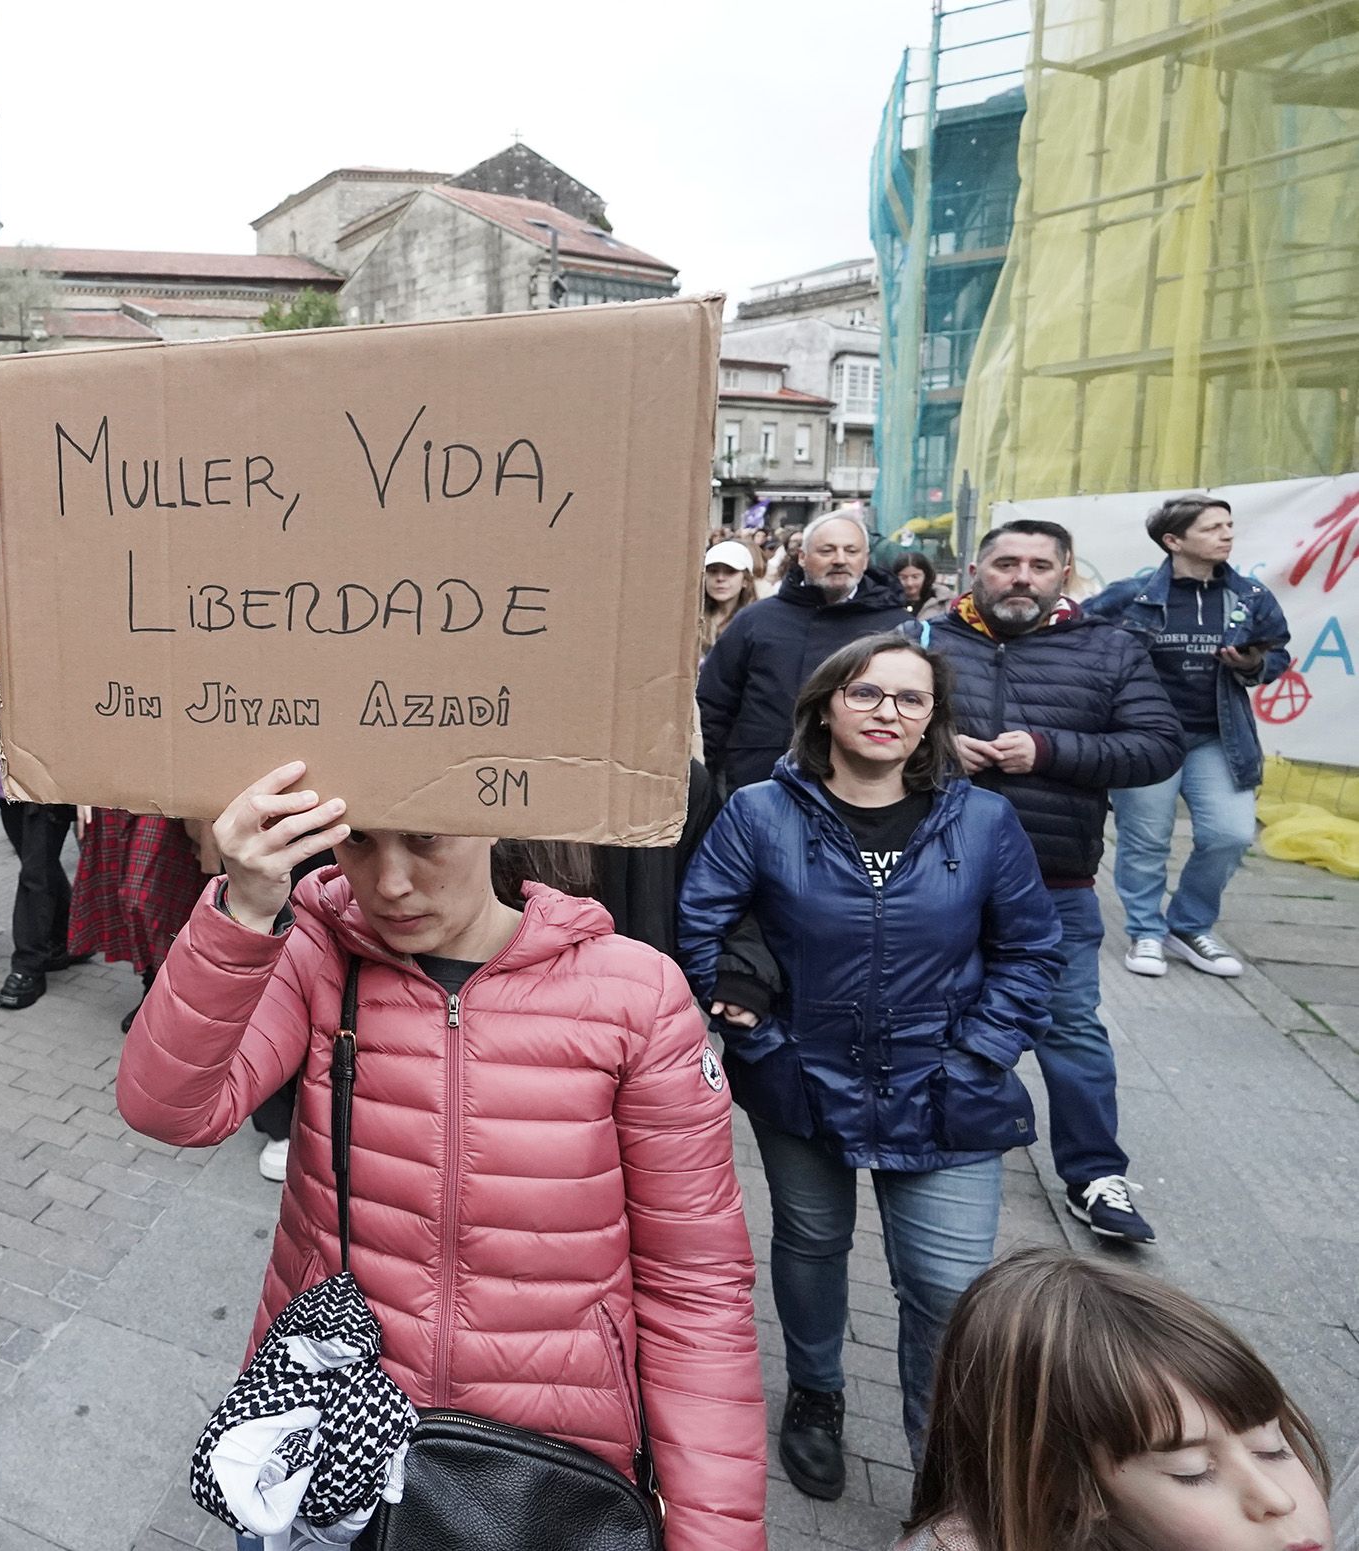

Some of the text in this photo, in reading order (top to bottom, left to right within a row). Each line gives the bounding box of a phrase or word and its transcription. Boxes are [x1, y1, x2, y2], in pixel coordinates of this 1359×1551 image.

[345, 405, 575, 528] VIDA,
[128, 549, 550, 636] LIBERDADE
[476, 766, 529, 807] 8M
